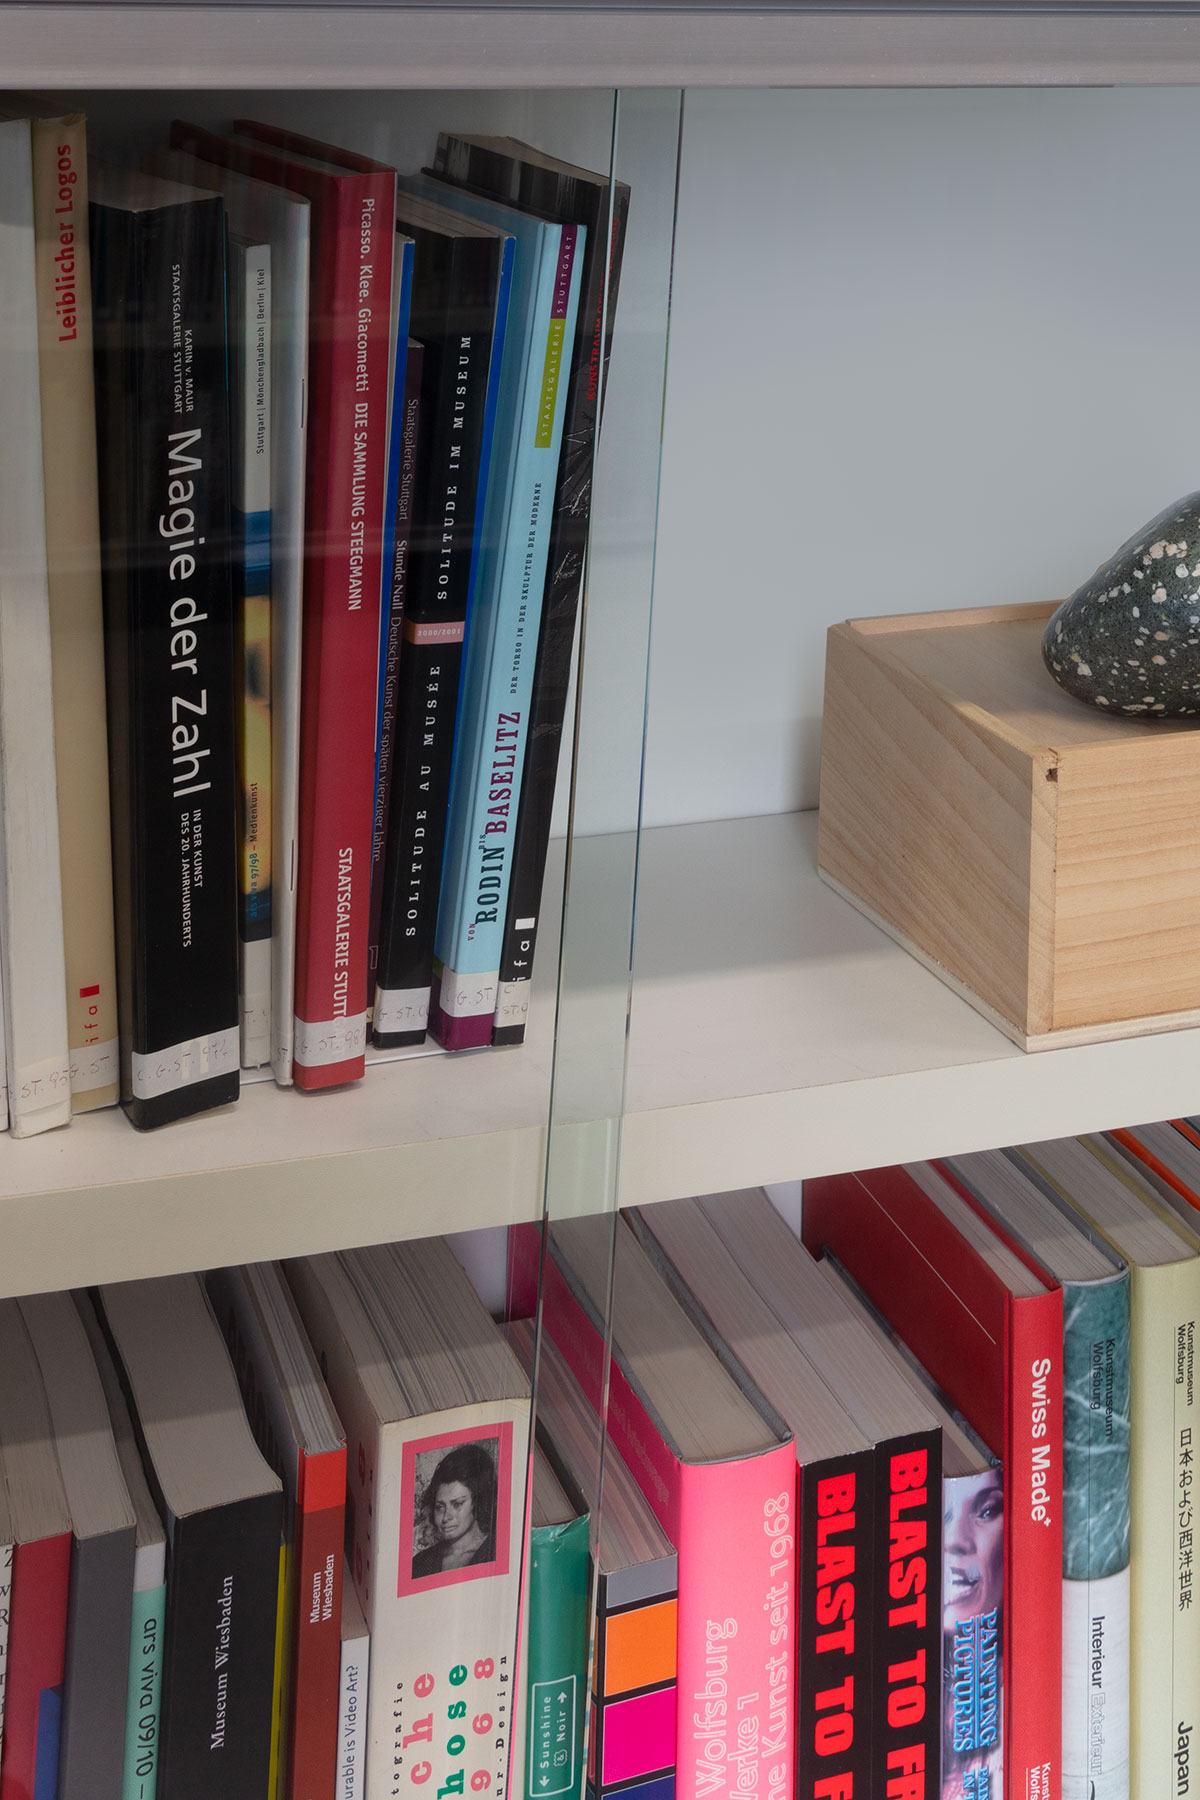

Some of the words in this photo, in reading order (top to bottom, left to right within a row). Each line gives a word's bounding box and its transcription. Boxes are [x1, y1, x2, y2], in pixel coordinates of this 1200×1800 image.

[55, 144, 77, 213] Logos
[360, 198, 374, 259] Picasso.
[55, 222, 76, 342] Leiblicher
[358, 264, 373, 303] Klee.
[355, 308, 371, 392] Giacometti
[354, 402, 368, 428] DIE
[160, 428, 203, 580] Magie
[351, 431, 367, 517] SAMMLUNG
[348, 521, 364, 610] STEEGMANN
[170, 597, 207, 675] der
[171, 689, 210, 798] Zahl
[423, 666, 440, 746] MUSÉE
[419, 765, 431, 791] AU
[484, 710, 520, 836] BASELITZ
[335, 847, 352, 968] STAATSGALERIE
[405, 810, 427, 936] SOLITUDE
[475, 841, 504, 922] RODIN
[1031, 1358, 1050, 1438] Swiss
[888, 1448, 927, 1627] BLAST
[1178, 1427, 1193, 1611] 日本および西洋世界
[815, 1472, 856, 1653] BLAST
[214, 1575, 233, 1670] Wiesbaden
[1091, 1616, 1105, 1688] Interieur
[210, 1672, 228, 1750] Museum
[814, 1675, 853, 1756] TO
[887, 1649, 925, 1728] TO
[1174, 1721, 1192, 1796] Japan
